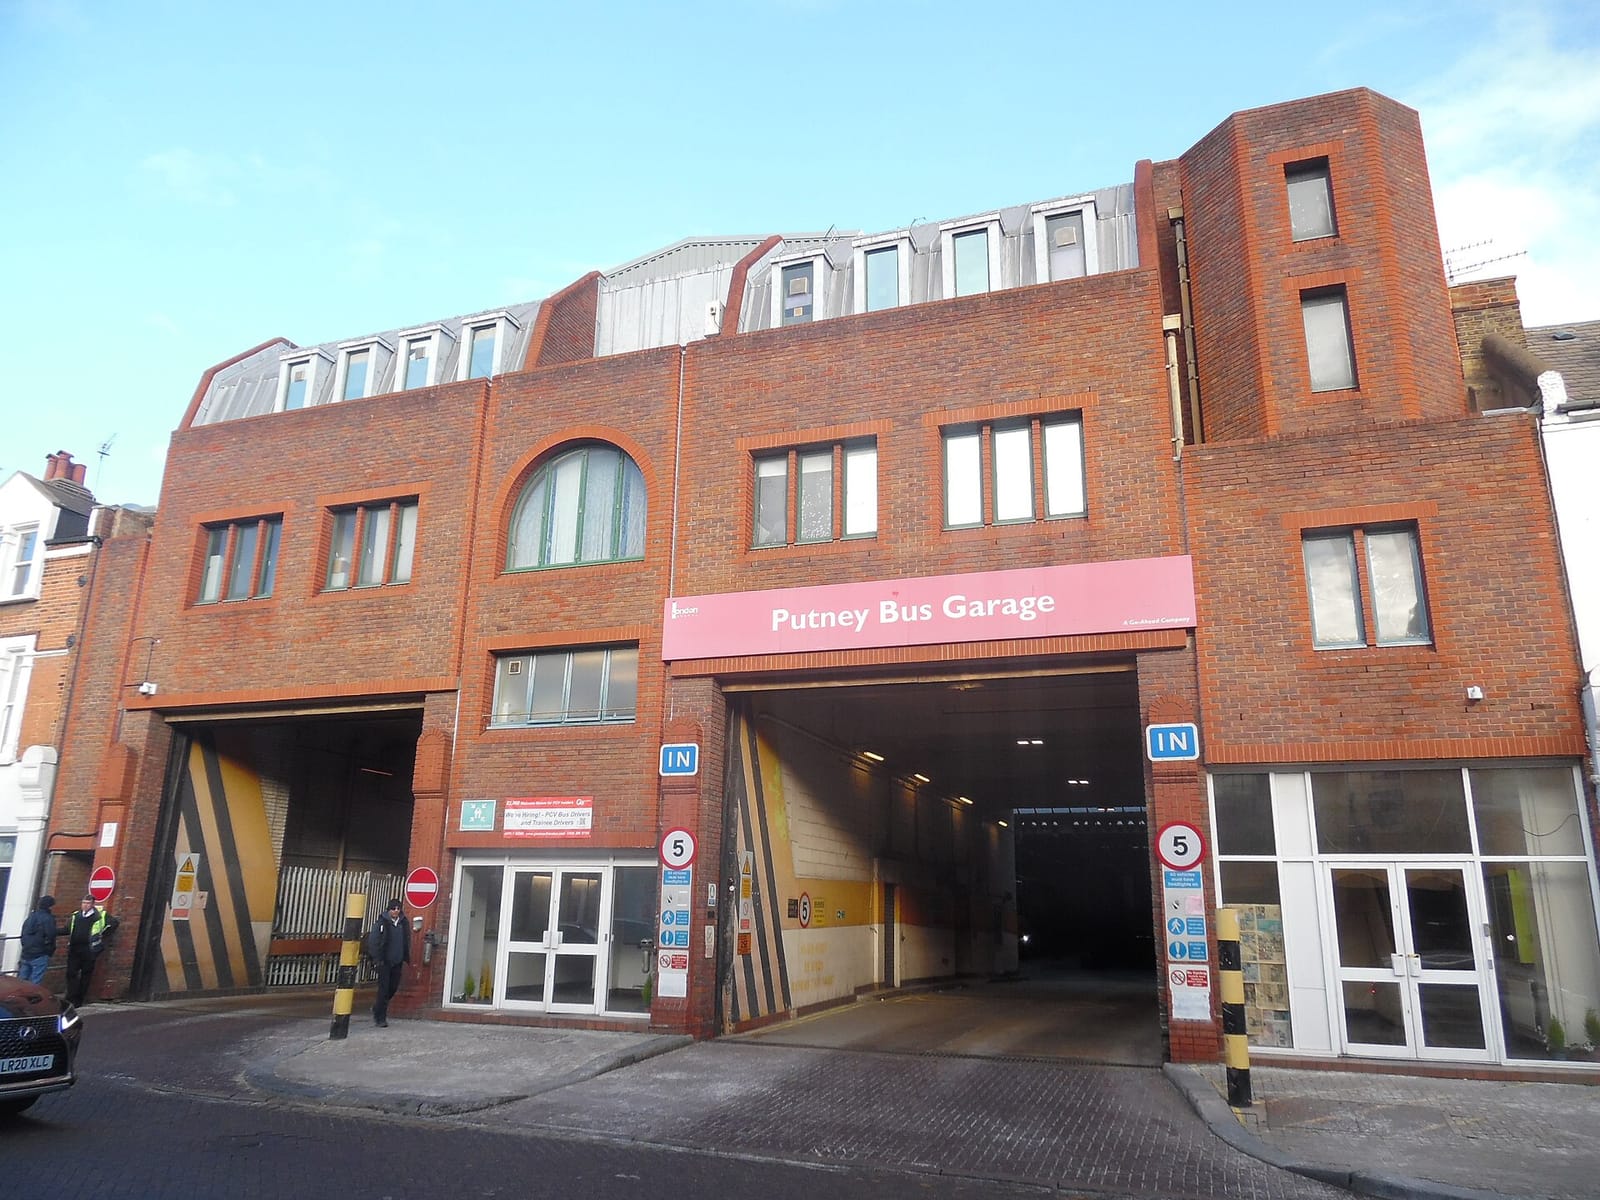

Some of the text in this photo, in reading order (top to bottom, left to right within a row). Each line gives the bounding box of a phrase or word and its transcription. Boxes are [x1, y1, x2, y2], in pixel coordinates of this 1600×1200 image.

[772, 594, 1056, 633] Putney Bus Garage
[1158, 731, 1188, 752] IN
[668, 751, 690, 768] IN
[673, 840, 684, 857] 5
[1173, 836, 1188, 856] 5
[802, 902, 808, 920] 5
[1, 1056, 50, 1072] LR20 XLC
